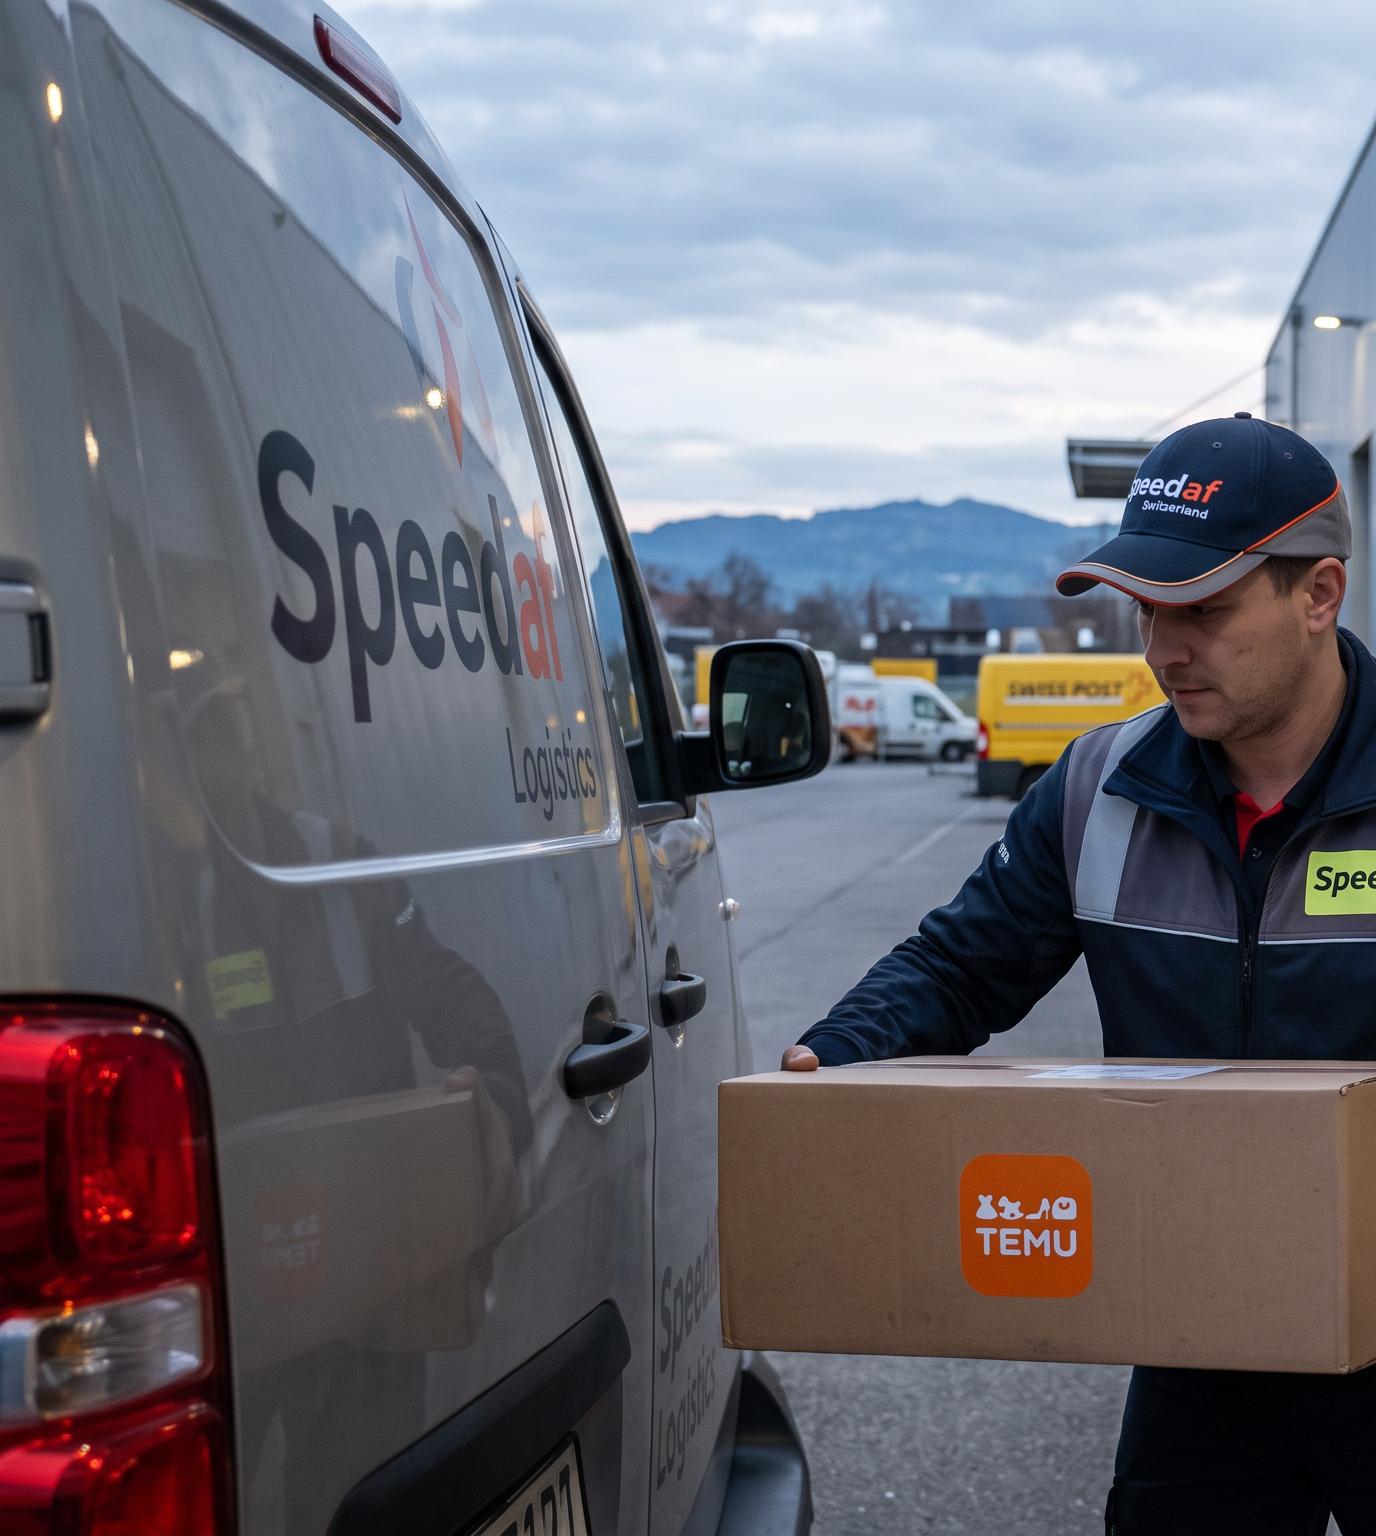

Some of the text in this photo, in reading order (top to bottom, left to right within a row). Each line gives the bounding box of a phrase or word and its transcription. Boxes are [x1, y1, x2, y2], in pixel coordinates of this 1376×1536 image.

[1127, 473, 1223, 503] peedaf
[1142, 500, 1208, 520] Switzerland
[258, 430, 563, 723] Speedaf
[1071, 680, 1124, 697] POST
[506, 726, 596, 821] Logistics
[975, 1227, 1077, 1258] TEMU
[657, 1344, 716, 1491] Logistics
